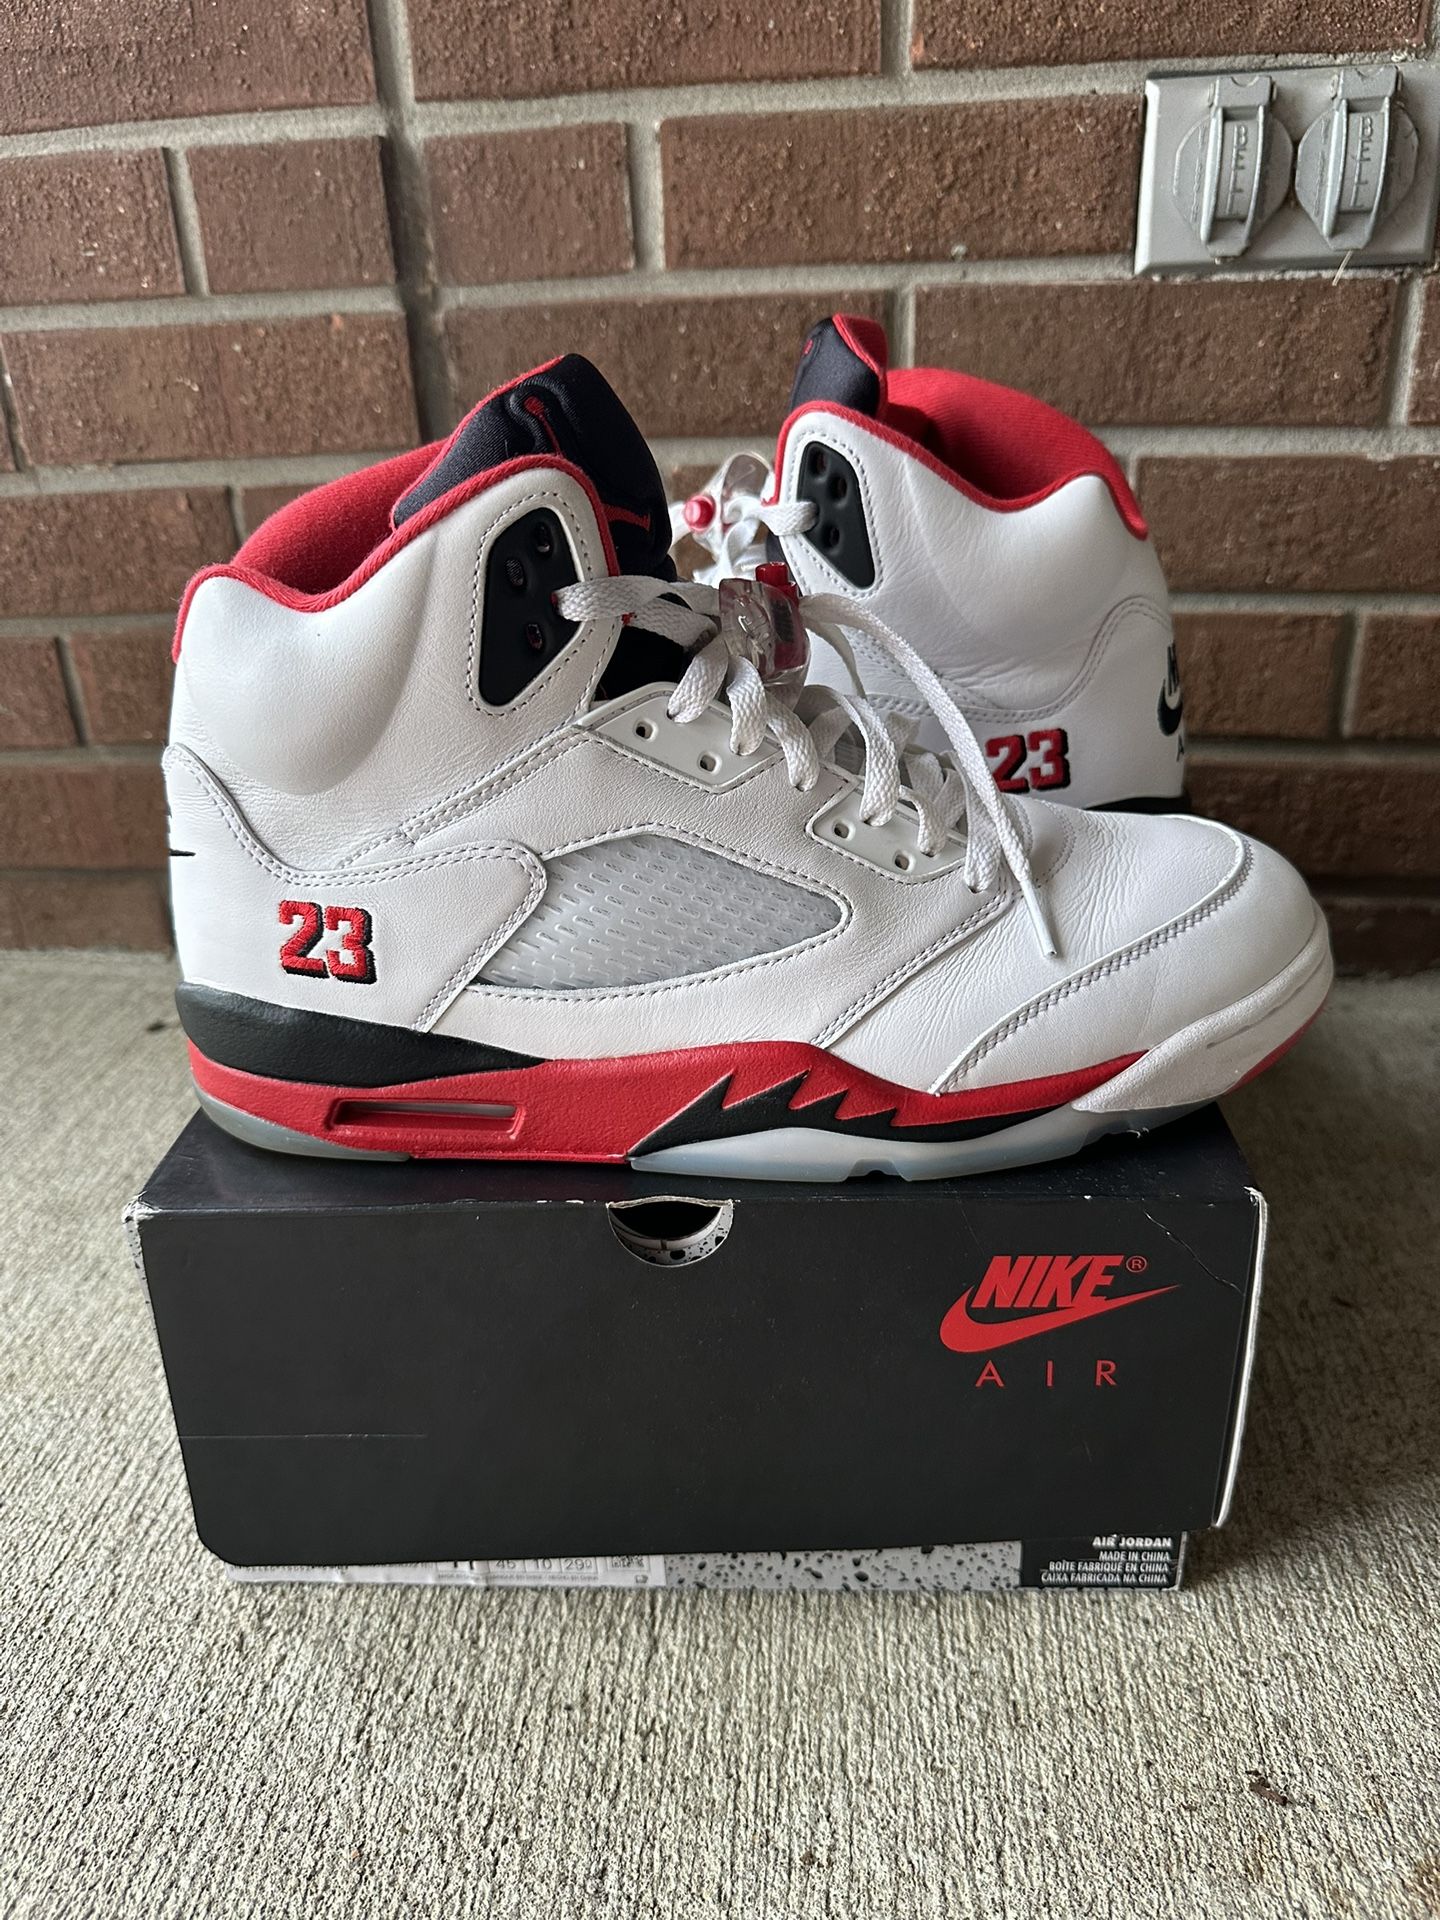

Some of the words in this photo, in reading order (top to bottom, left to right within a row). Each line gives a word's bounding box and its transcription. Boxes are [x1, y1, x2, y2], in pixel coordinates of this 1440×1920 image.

[984, 727, 1071, 794] 23
[278, 899, 378, 985] 23
[975, 1359, 1118, 1388] AIR
[1092, 1536, 1115, 1547] AIR
[1118, 1537, 1172, 1547] JORDAN
[1099, 1551, 1126, 1561] MADE
[1128, 1551, 1139, 1561] IN
[1141, 1551, 1170, 1561] CHINA
[1078, 1560, 1123, 1572] FABRIQUÉ
[1125, 1562, 1137, 1572] EN
[1041, 1572, 1068, 1582] CAIXA
[1070, 1572, 1120, 1583] FABRICADA
[1122, 1572, 1136, 1582] NA
[1138, 1572, 1167, 1582] CHINA
